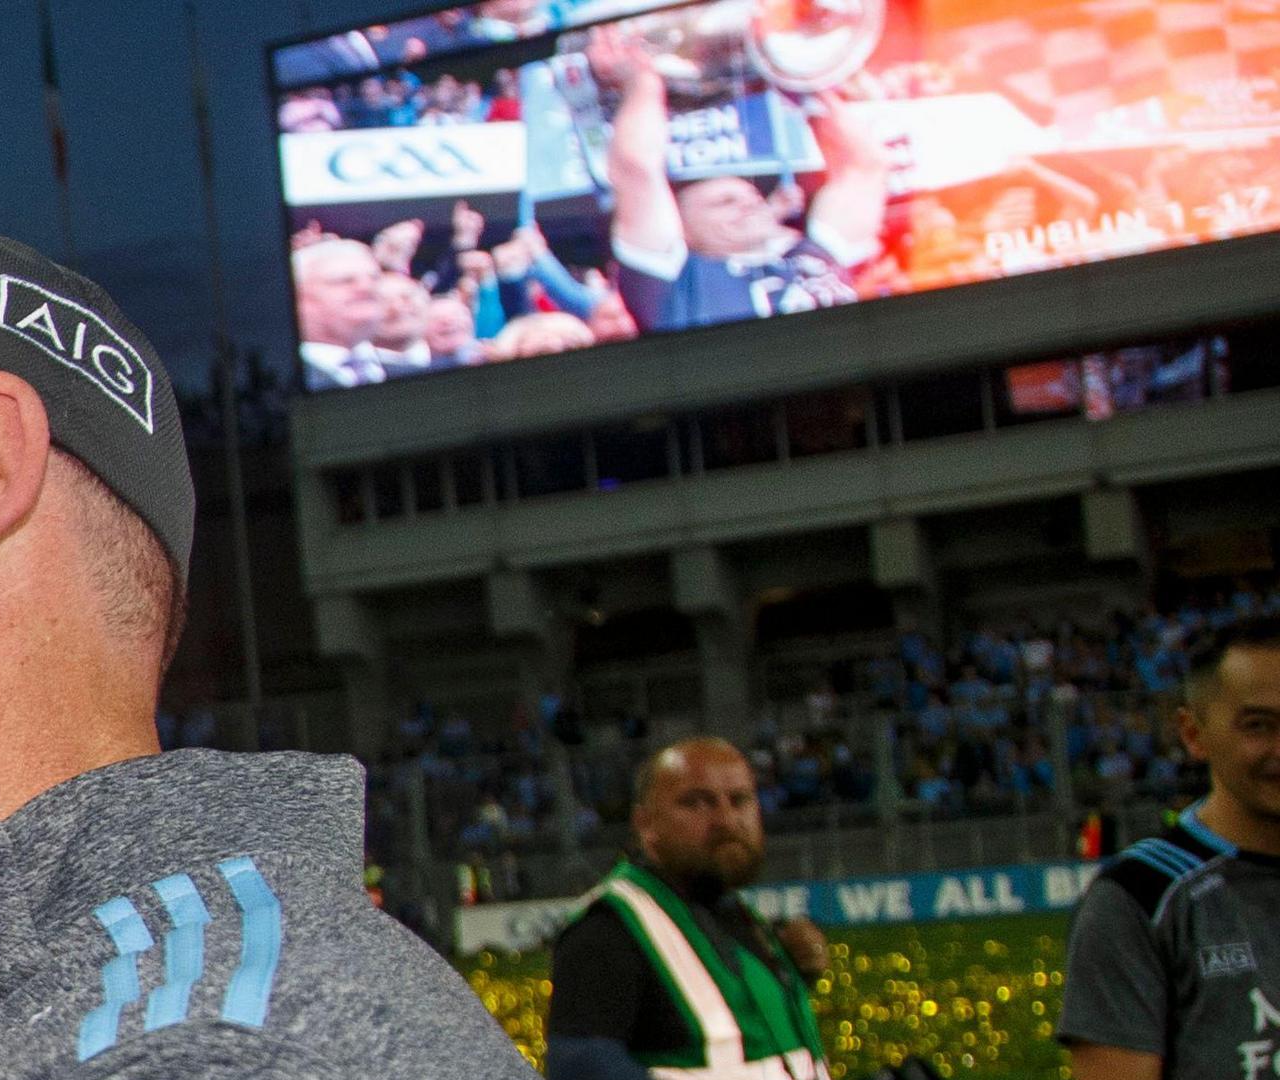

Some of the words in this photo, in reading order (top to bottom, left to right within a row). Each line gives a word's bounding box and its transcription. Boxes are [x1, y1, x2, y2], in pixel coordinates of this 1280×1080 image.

[15, 301, 135, 394] AIG
[839, 880, 913, 923] WE
[933, 873, 1026, 918] ALL
